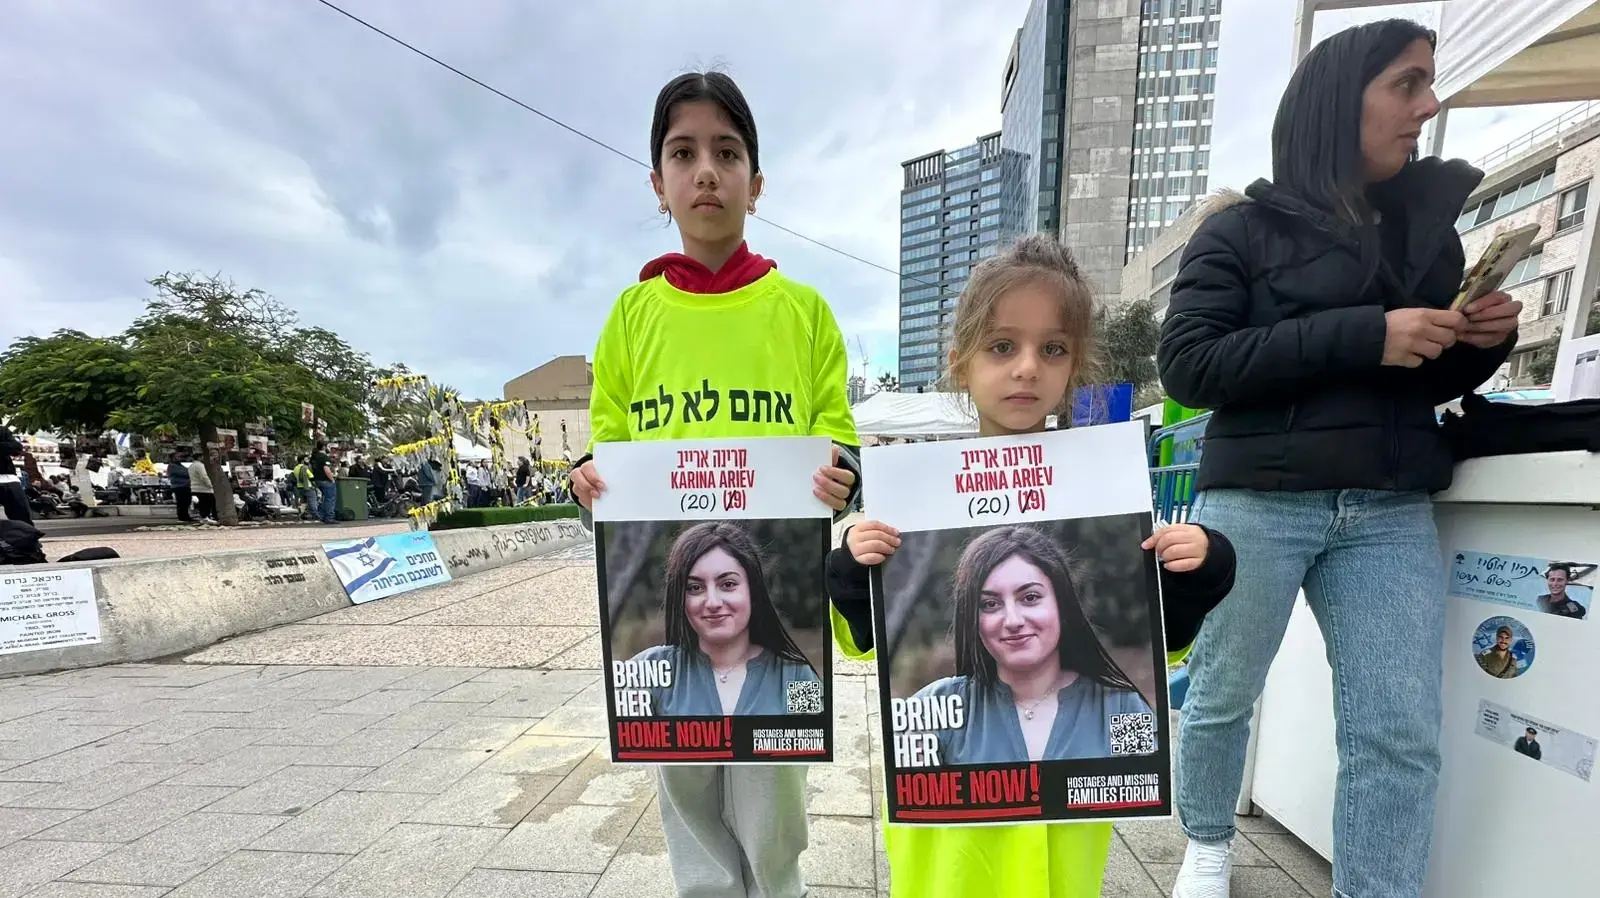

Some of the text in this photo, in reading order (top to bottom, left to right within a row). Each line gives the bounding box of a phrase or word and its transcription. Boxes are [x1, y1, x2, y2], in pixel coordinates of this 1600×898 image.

[631, 379, 794, 432] אתם לא לבד
[677, 449, 747, 471] קרינה ארייב
[961, 444, 1043, 471] קרינה ארייב
[671, 470, 754, 489] KARINA ARIEV
[955, 466, 1053, 493] KARINA ARIEV
[681, 493, 716, 512] (20)
[968, 494, 1010, 519] (20)
[405, 551, 437, 565] מחכים
[31, 575, 62, 583] מיכאל
[371, 564, 443, 590] לשובכם הביתה
[0, 610, 75, 622] MICHAEL GROSS
[613, 660, 672, 688] BRING
[615, 690, 653, 717] HER
[891, 694, 964, 732] BRING
[617, 717, 733, 748] HOME NOW!
[753, 729, 824, 738] HOSTAGES AND MISSING
[753, 738, 824, 751] FAMILIES FORUM
[895, 734, 941, 768] HER
[896, 763, 1040, 806] HOME NOW!
[1067, 773, 1158, 788] HOSTAGES AND MISSING
[1068, 785, 1159, 804] FAMILIES FORUM
